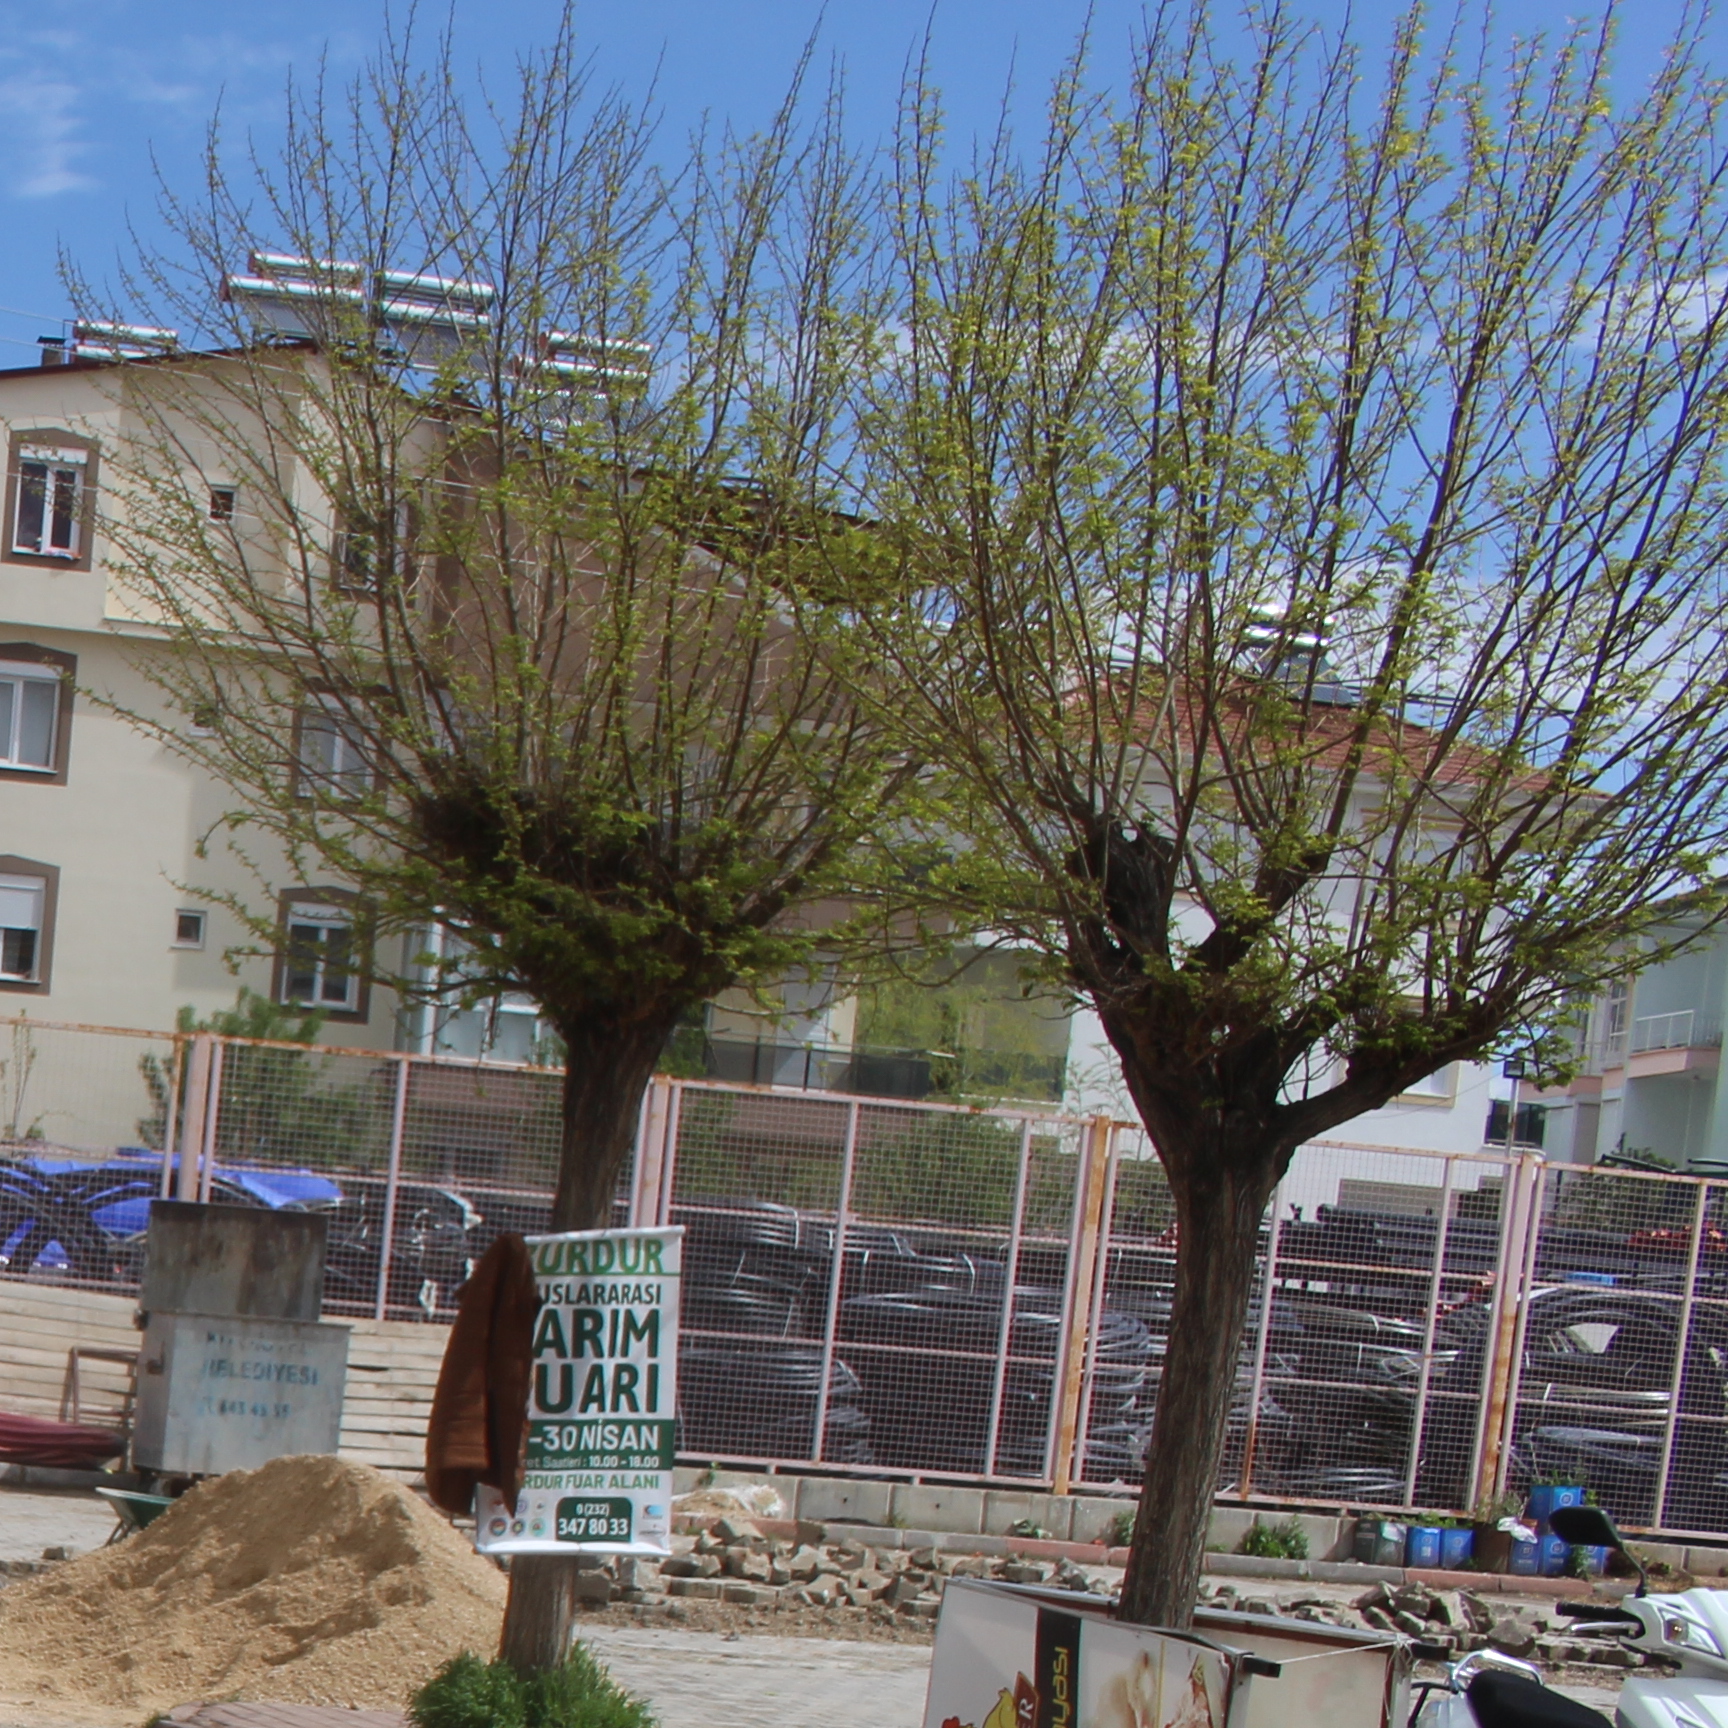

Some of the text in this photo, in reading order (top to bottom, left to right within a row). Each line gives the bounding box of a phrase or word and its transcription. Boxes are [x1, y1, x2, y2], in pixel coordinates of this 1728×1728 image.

[529, 1238, 664, 1275] URDUR
[580, 1419, 659, 1451] NİSAN
[565, 1475, 604, 1489] FUAR
[608, 1475, 659, 1489] ALANI
[558, 1518, 628, 1536] 347 80 33
